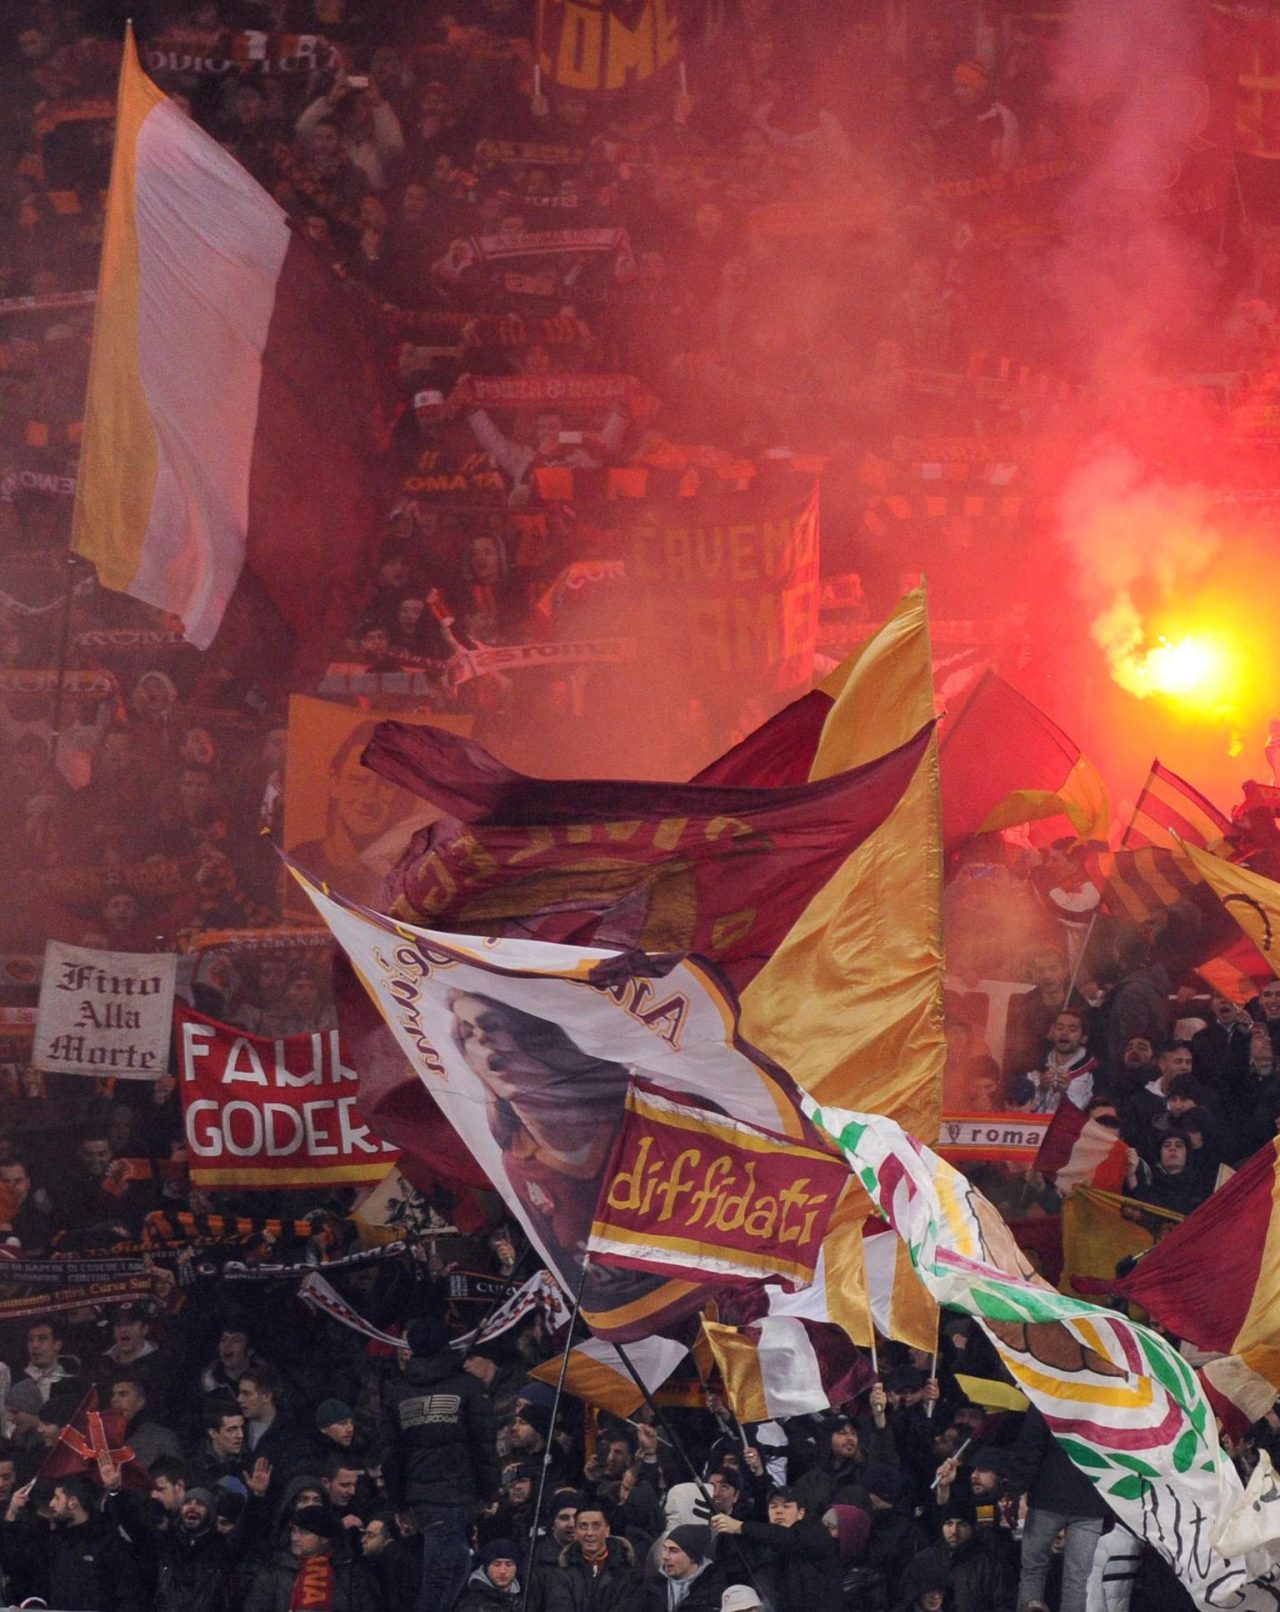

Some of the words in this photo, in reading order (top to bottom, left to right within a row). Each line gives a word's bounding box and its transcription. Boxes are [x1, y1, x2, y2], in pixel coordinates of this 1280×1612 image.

[55, 961, 161, 996] Fino
[74, 1000, 141, 1031] Alla
[47, 1034, 158, 1069] Morte
[186, 1096, 401, 1158] GODER
[971, 1125, 1041, 1146] roma
[607, 1137, 827, 1245] diffidati
[130, 1277, 151, 1289] Sud
